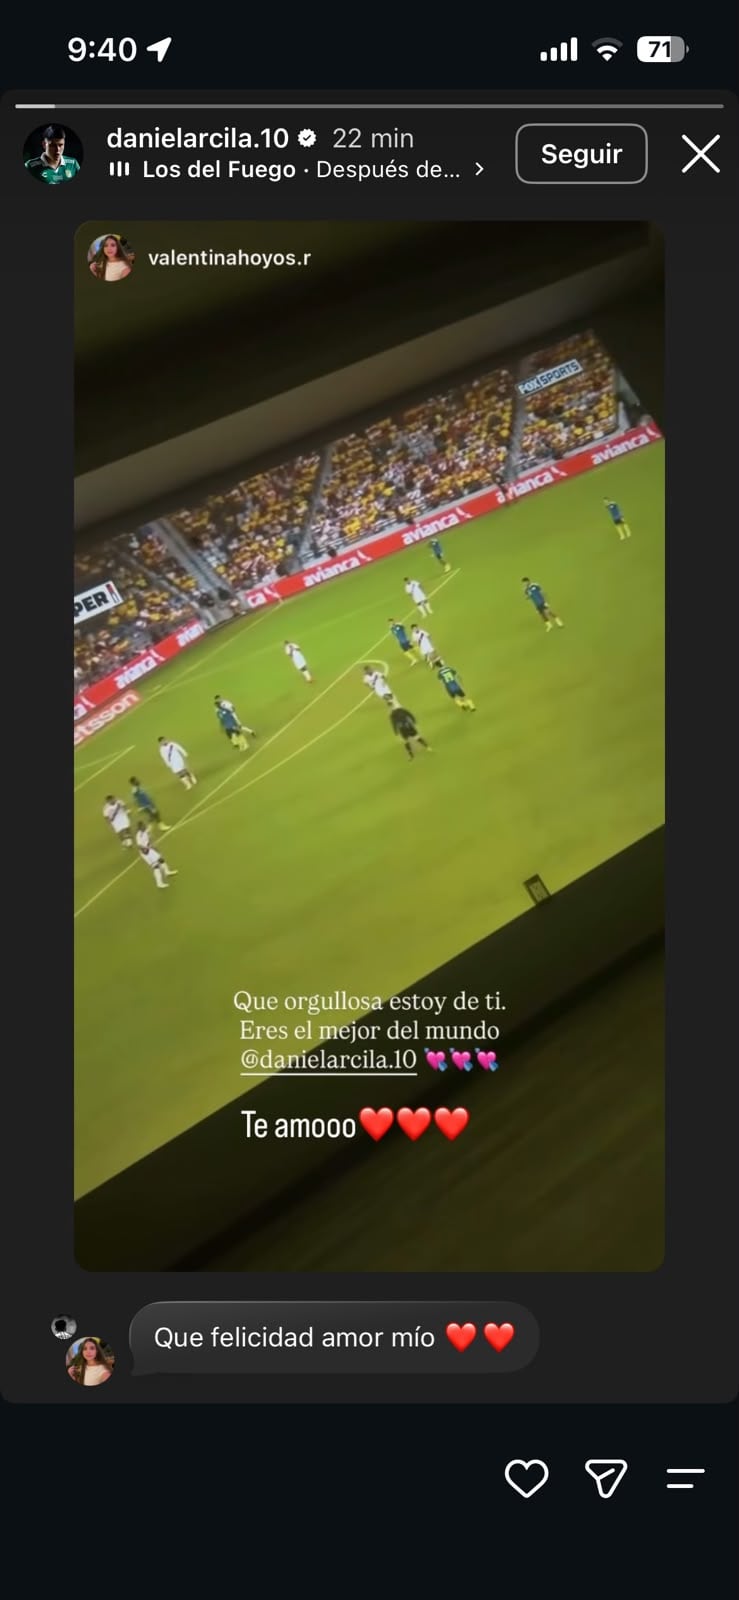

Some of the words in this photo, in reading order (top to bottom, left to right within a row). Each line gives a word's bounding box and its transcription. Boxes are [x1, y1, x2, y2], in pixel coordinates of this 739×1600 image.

[539, 361, 580, 385] SPORTS
[591, 432, 650, 465] avianca
[401, 512, 459, 546] avianca
[303, 555, 361, 588] avianca
